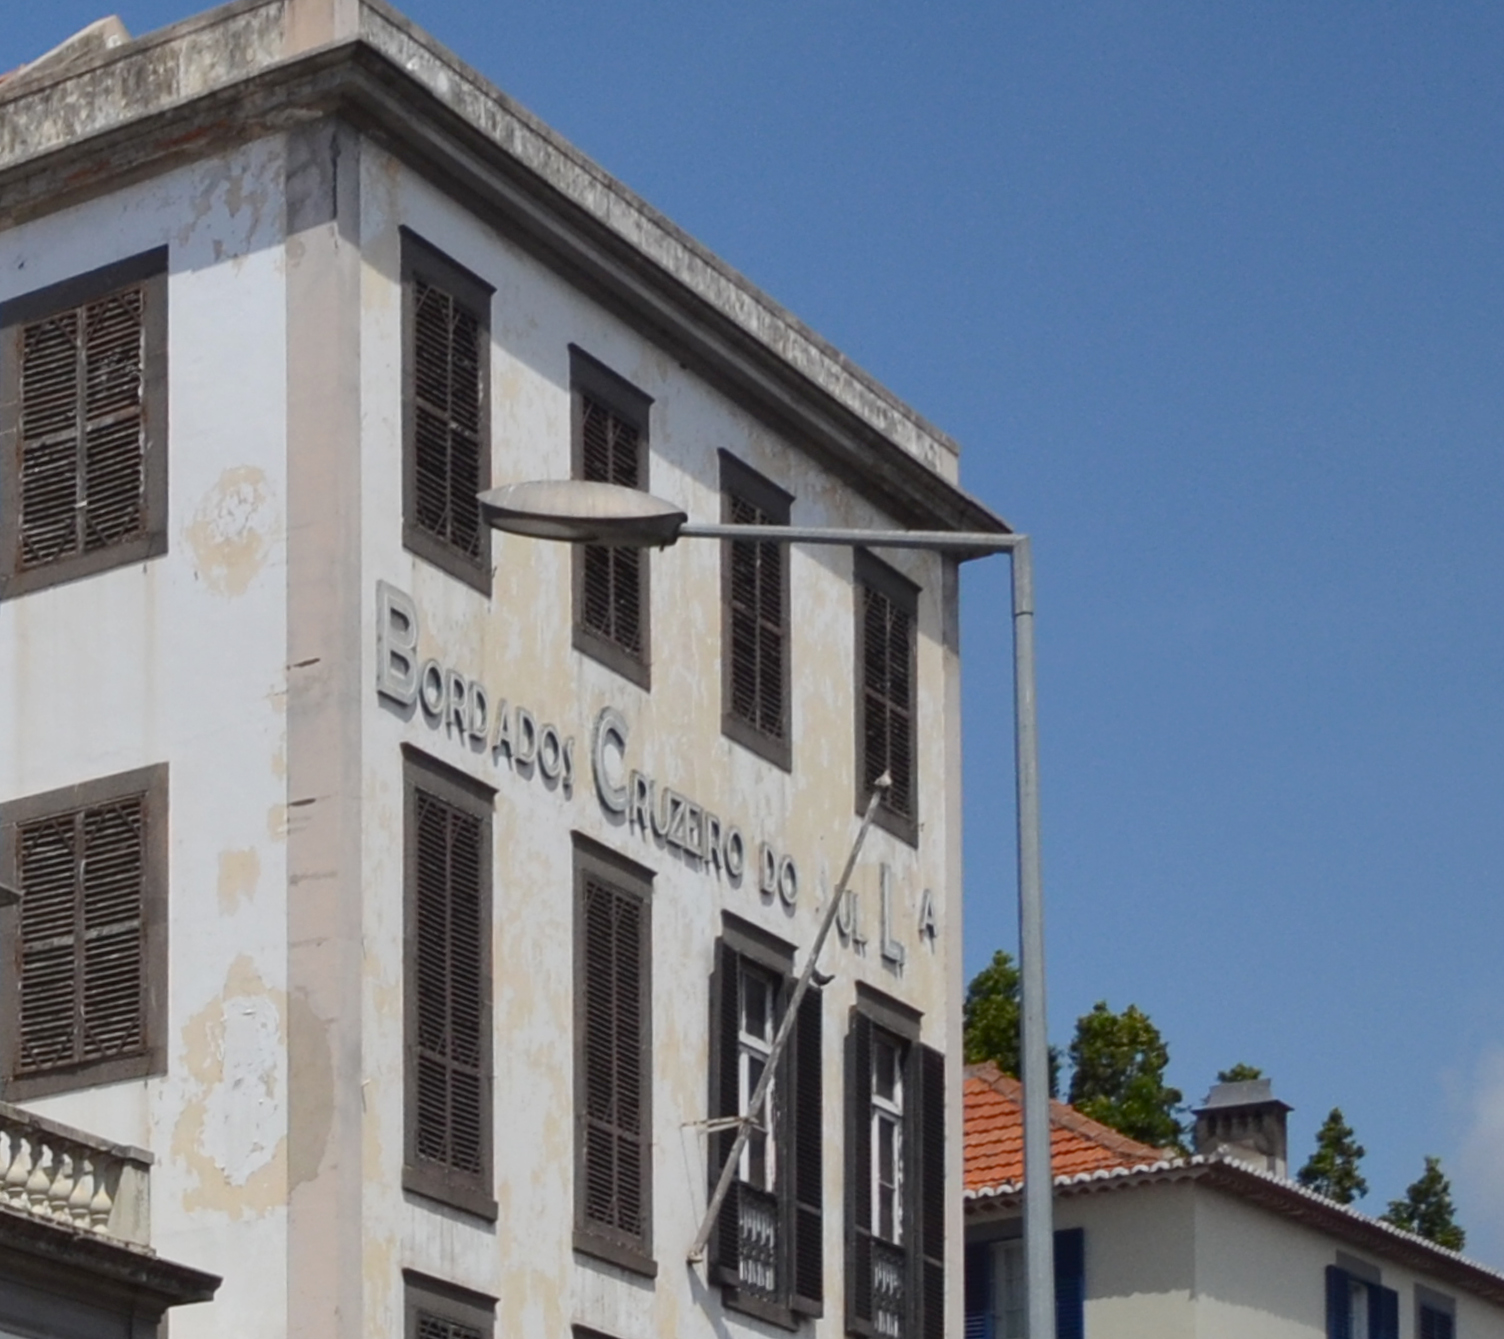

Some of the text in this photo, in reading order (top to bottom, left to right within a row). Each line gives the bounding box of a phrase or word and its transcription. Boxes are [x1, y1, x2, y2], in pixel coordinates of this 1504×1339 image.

[375, 578, 576, 792] BORDADOS
[591, 705, 746, 880] CRUZEIRO
[758, 841, 799, 905] DO
